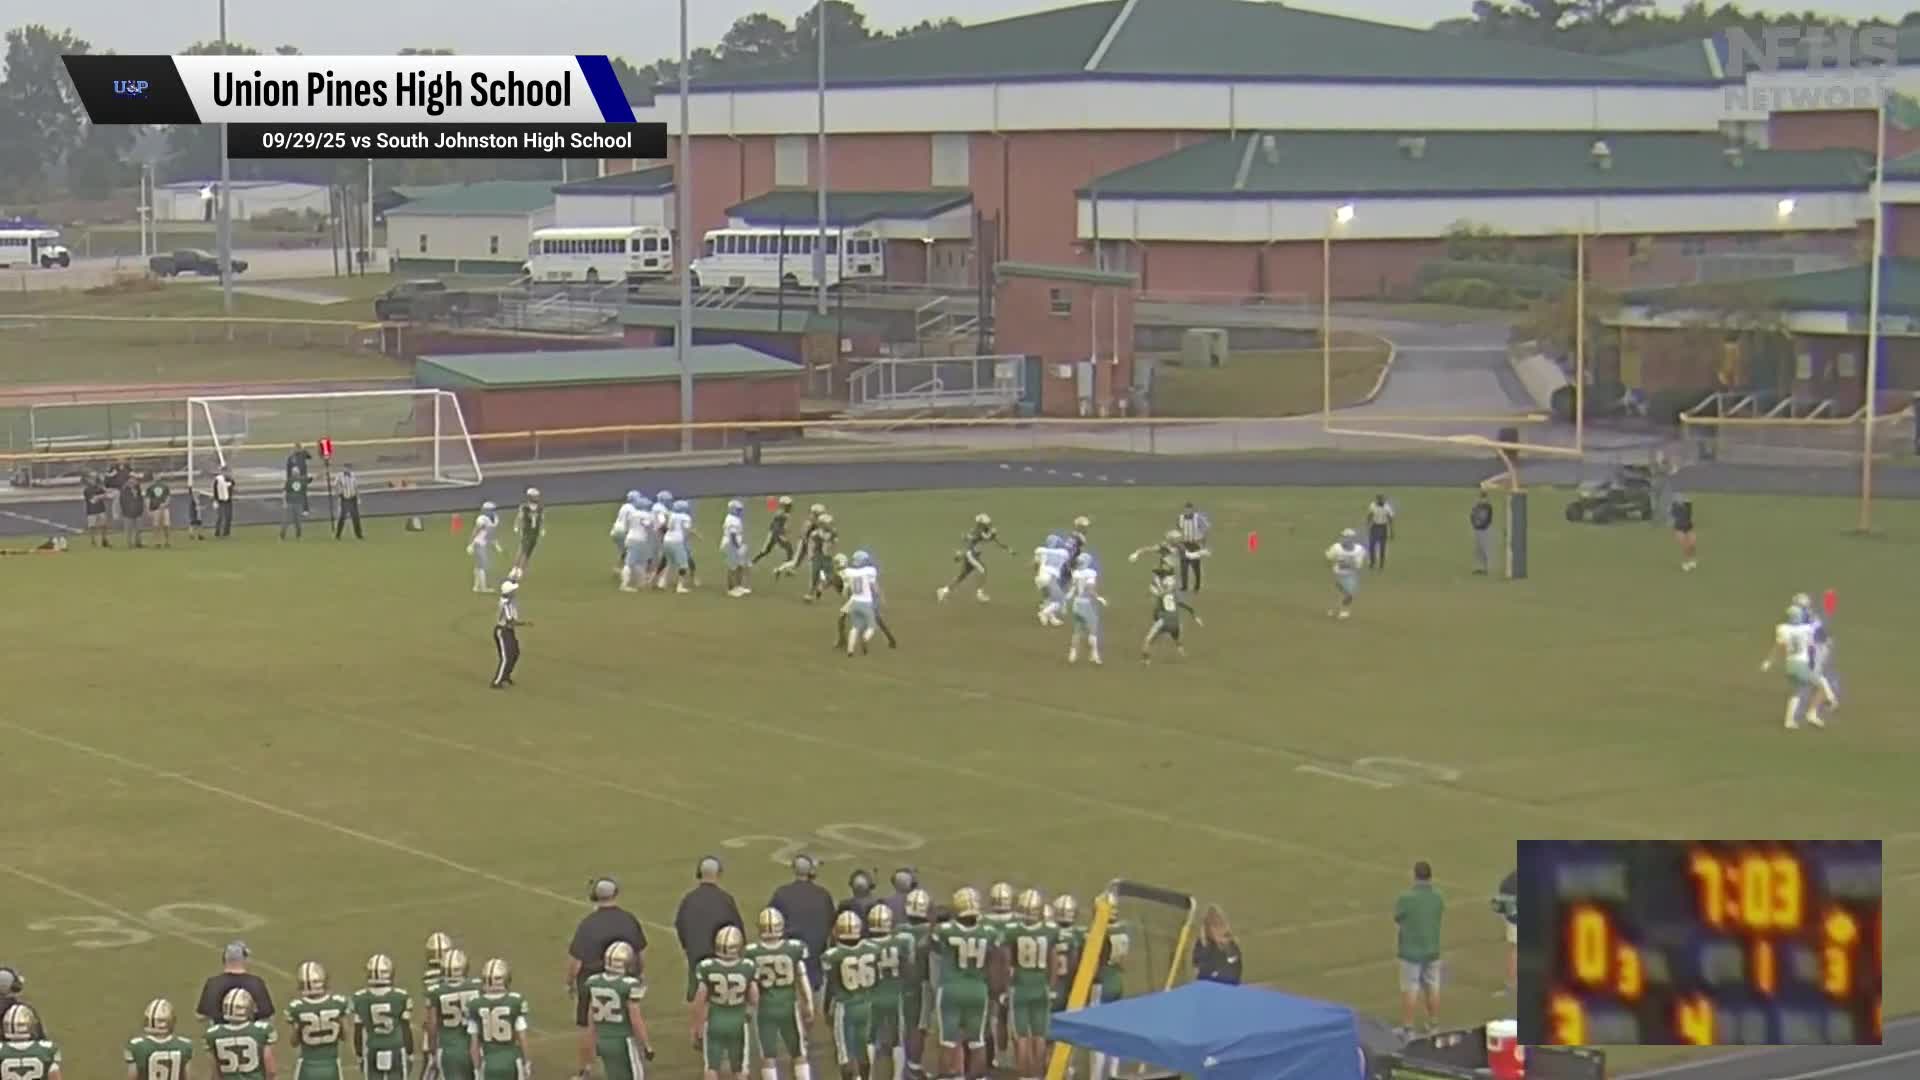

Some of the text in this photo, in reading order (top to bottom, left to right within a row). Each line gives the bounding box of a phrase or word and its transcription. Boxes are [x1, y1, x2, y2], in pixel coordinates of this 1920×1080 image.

[1688, 853, 1802, 929] 7:03
[948, 936, 987, 968] 74
[1018, 936, 1048, 968] 81
[1571, 906, 1608, 985] 0
[708, 973, 747, 1005] 32
[756, 955, 794, 988] 59
[841, 953, 875, 990] 66
[300, 1009, 340, 1045] 25
[370, 1003, 394, 1034] 5
[479, 1006, 512, 1041] 16
[216, 1037, 258, 1072] 53
